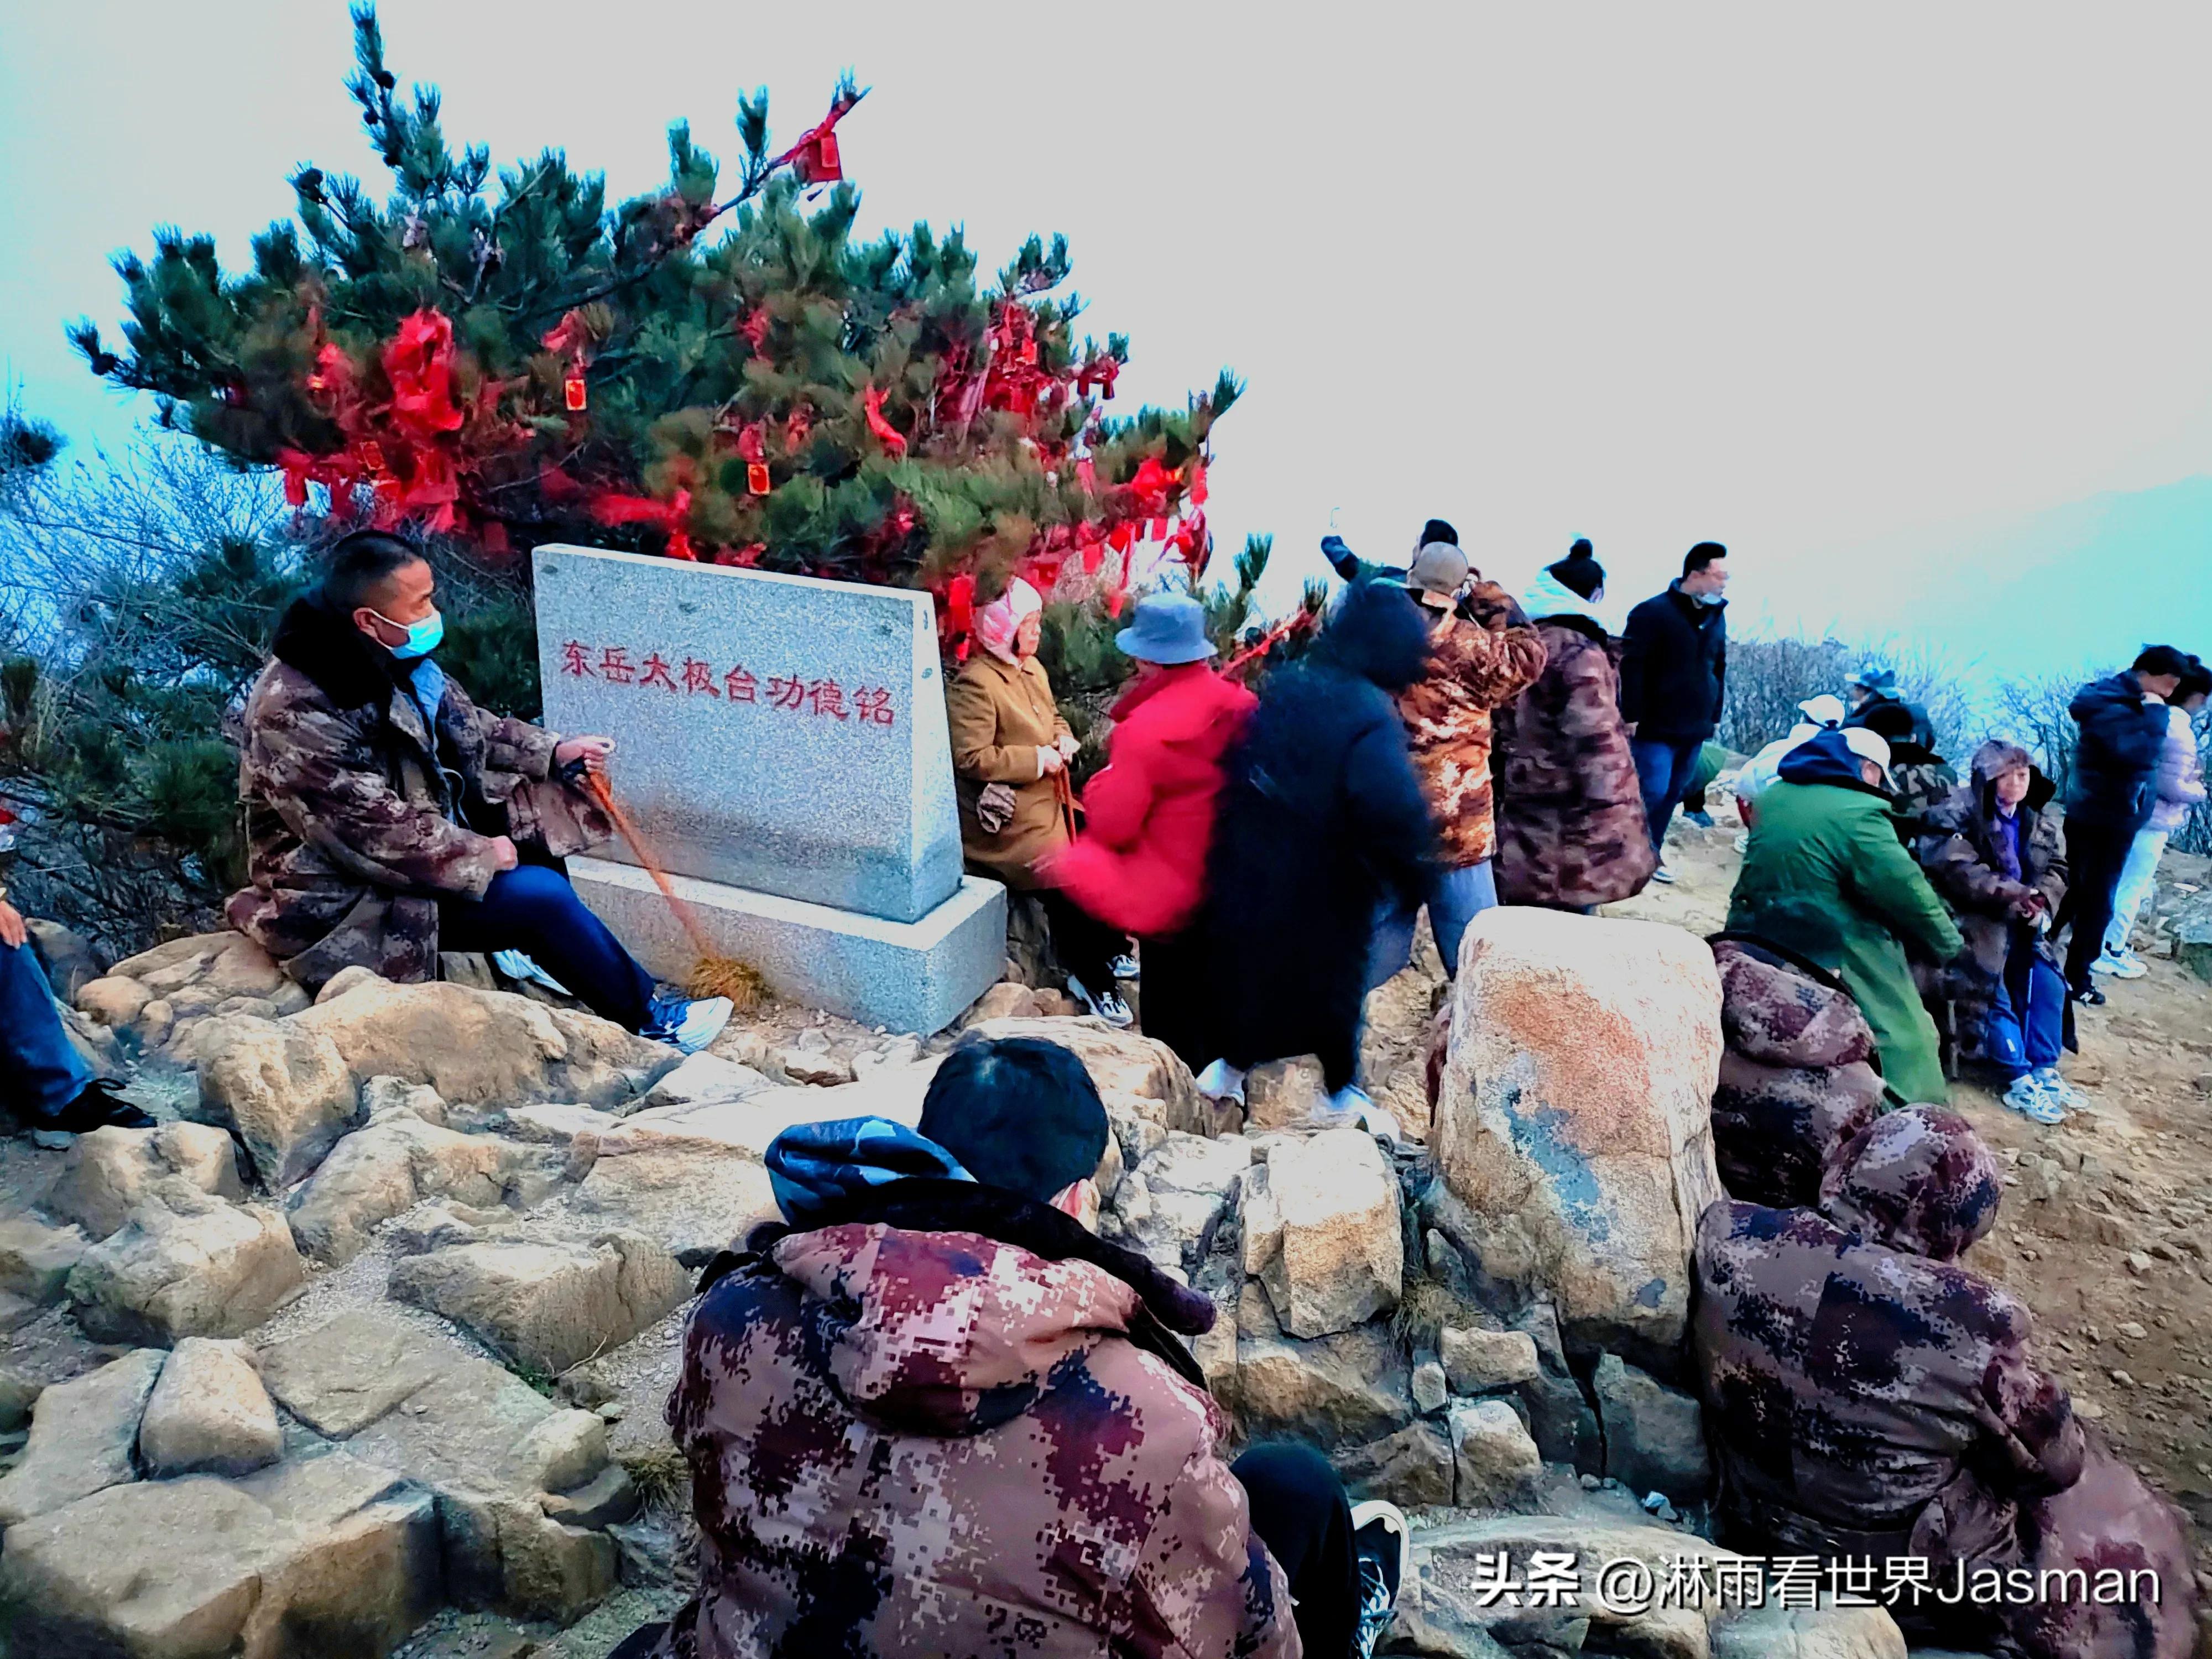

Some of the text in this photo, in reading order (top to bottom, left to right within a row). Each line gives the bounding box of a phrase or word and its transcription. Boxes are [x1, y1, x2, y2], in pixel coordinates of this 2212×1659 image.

[561, 639, 895, 726] 东岳太极台功德铭
